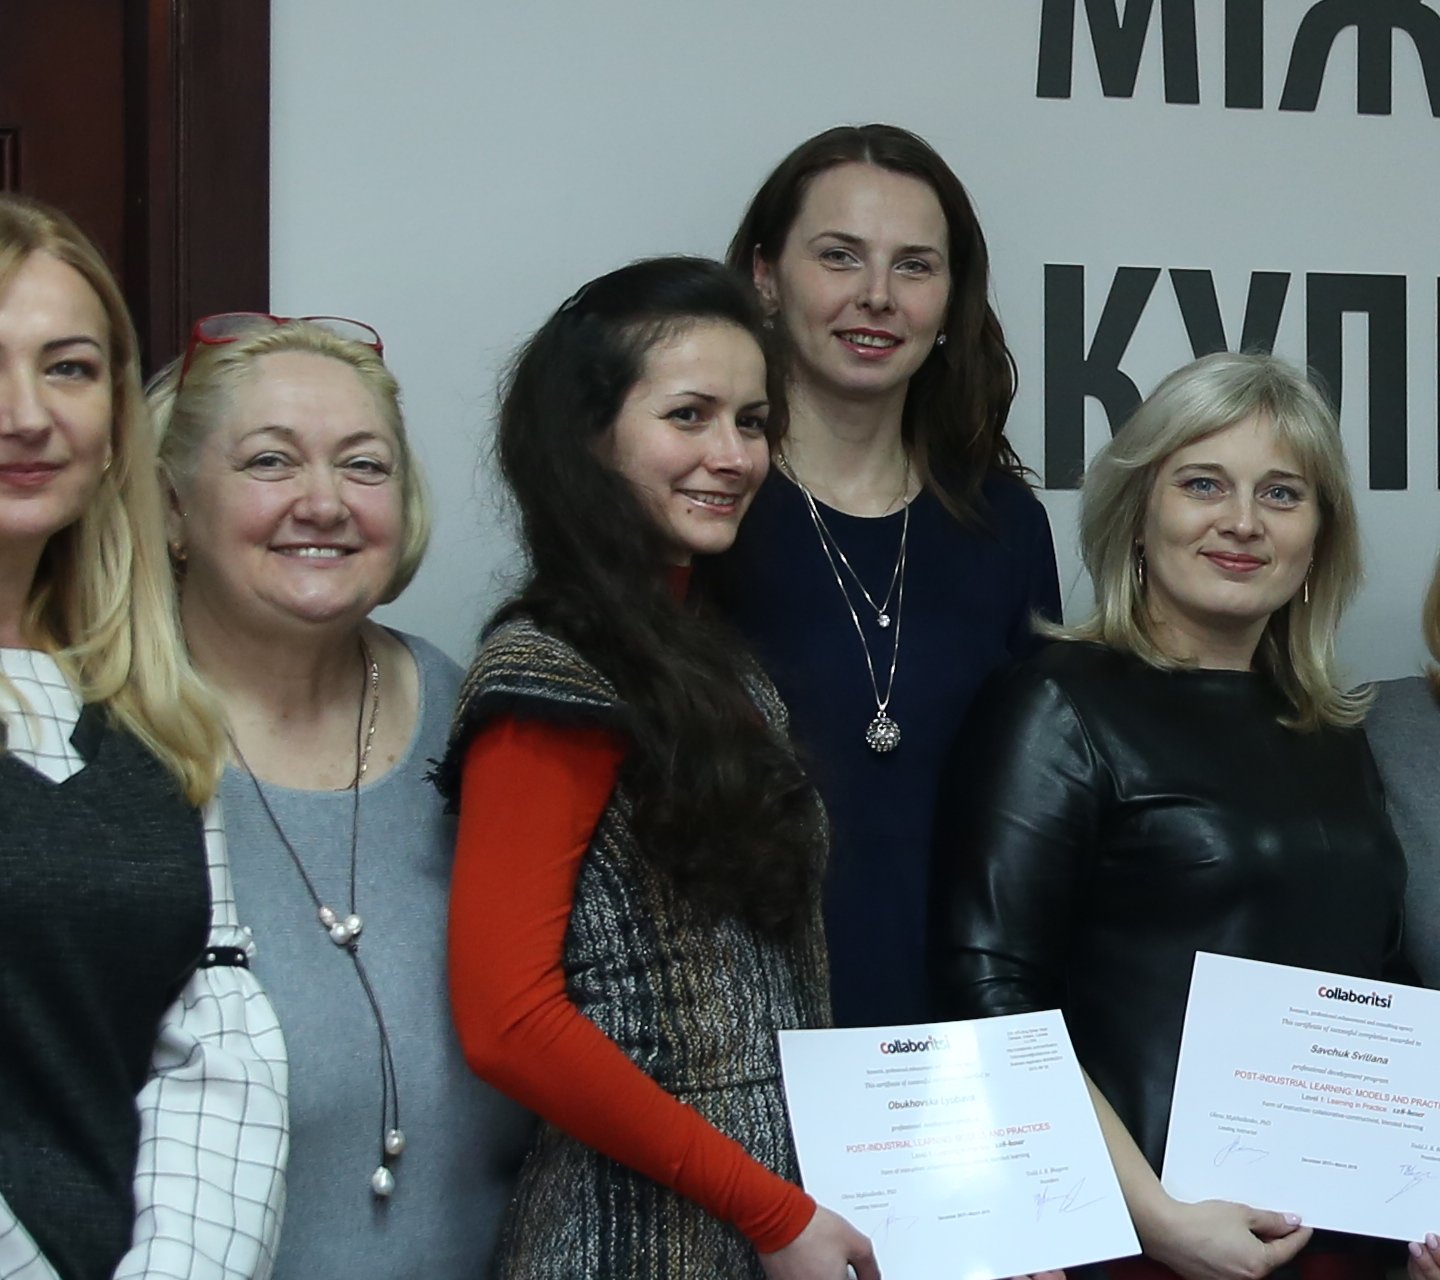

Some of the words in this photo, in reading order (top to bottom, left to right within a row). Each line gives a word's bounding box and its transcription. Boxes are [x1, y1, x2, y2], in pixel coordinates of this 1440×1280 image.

[1354, 1088, 1390, 1102] MODELS
[1390, 1093, 1410, 1105] AND
[1005, 1121, 1051, 1135] PRACTICES
